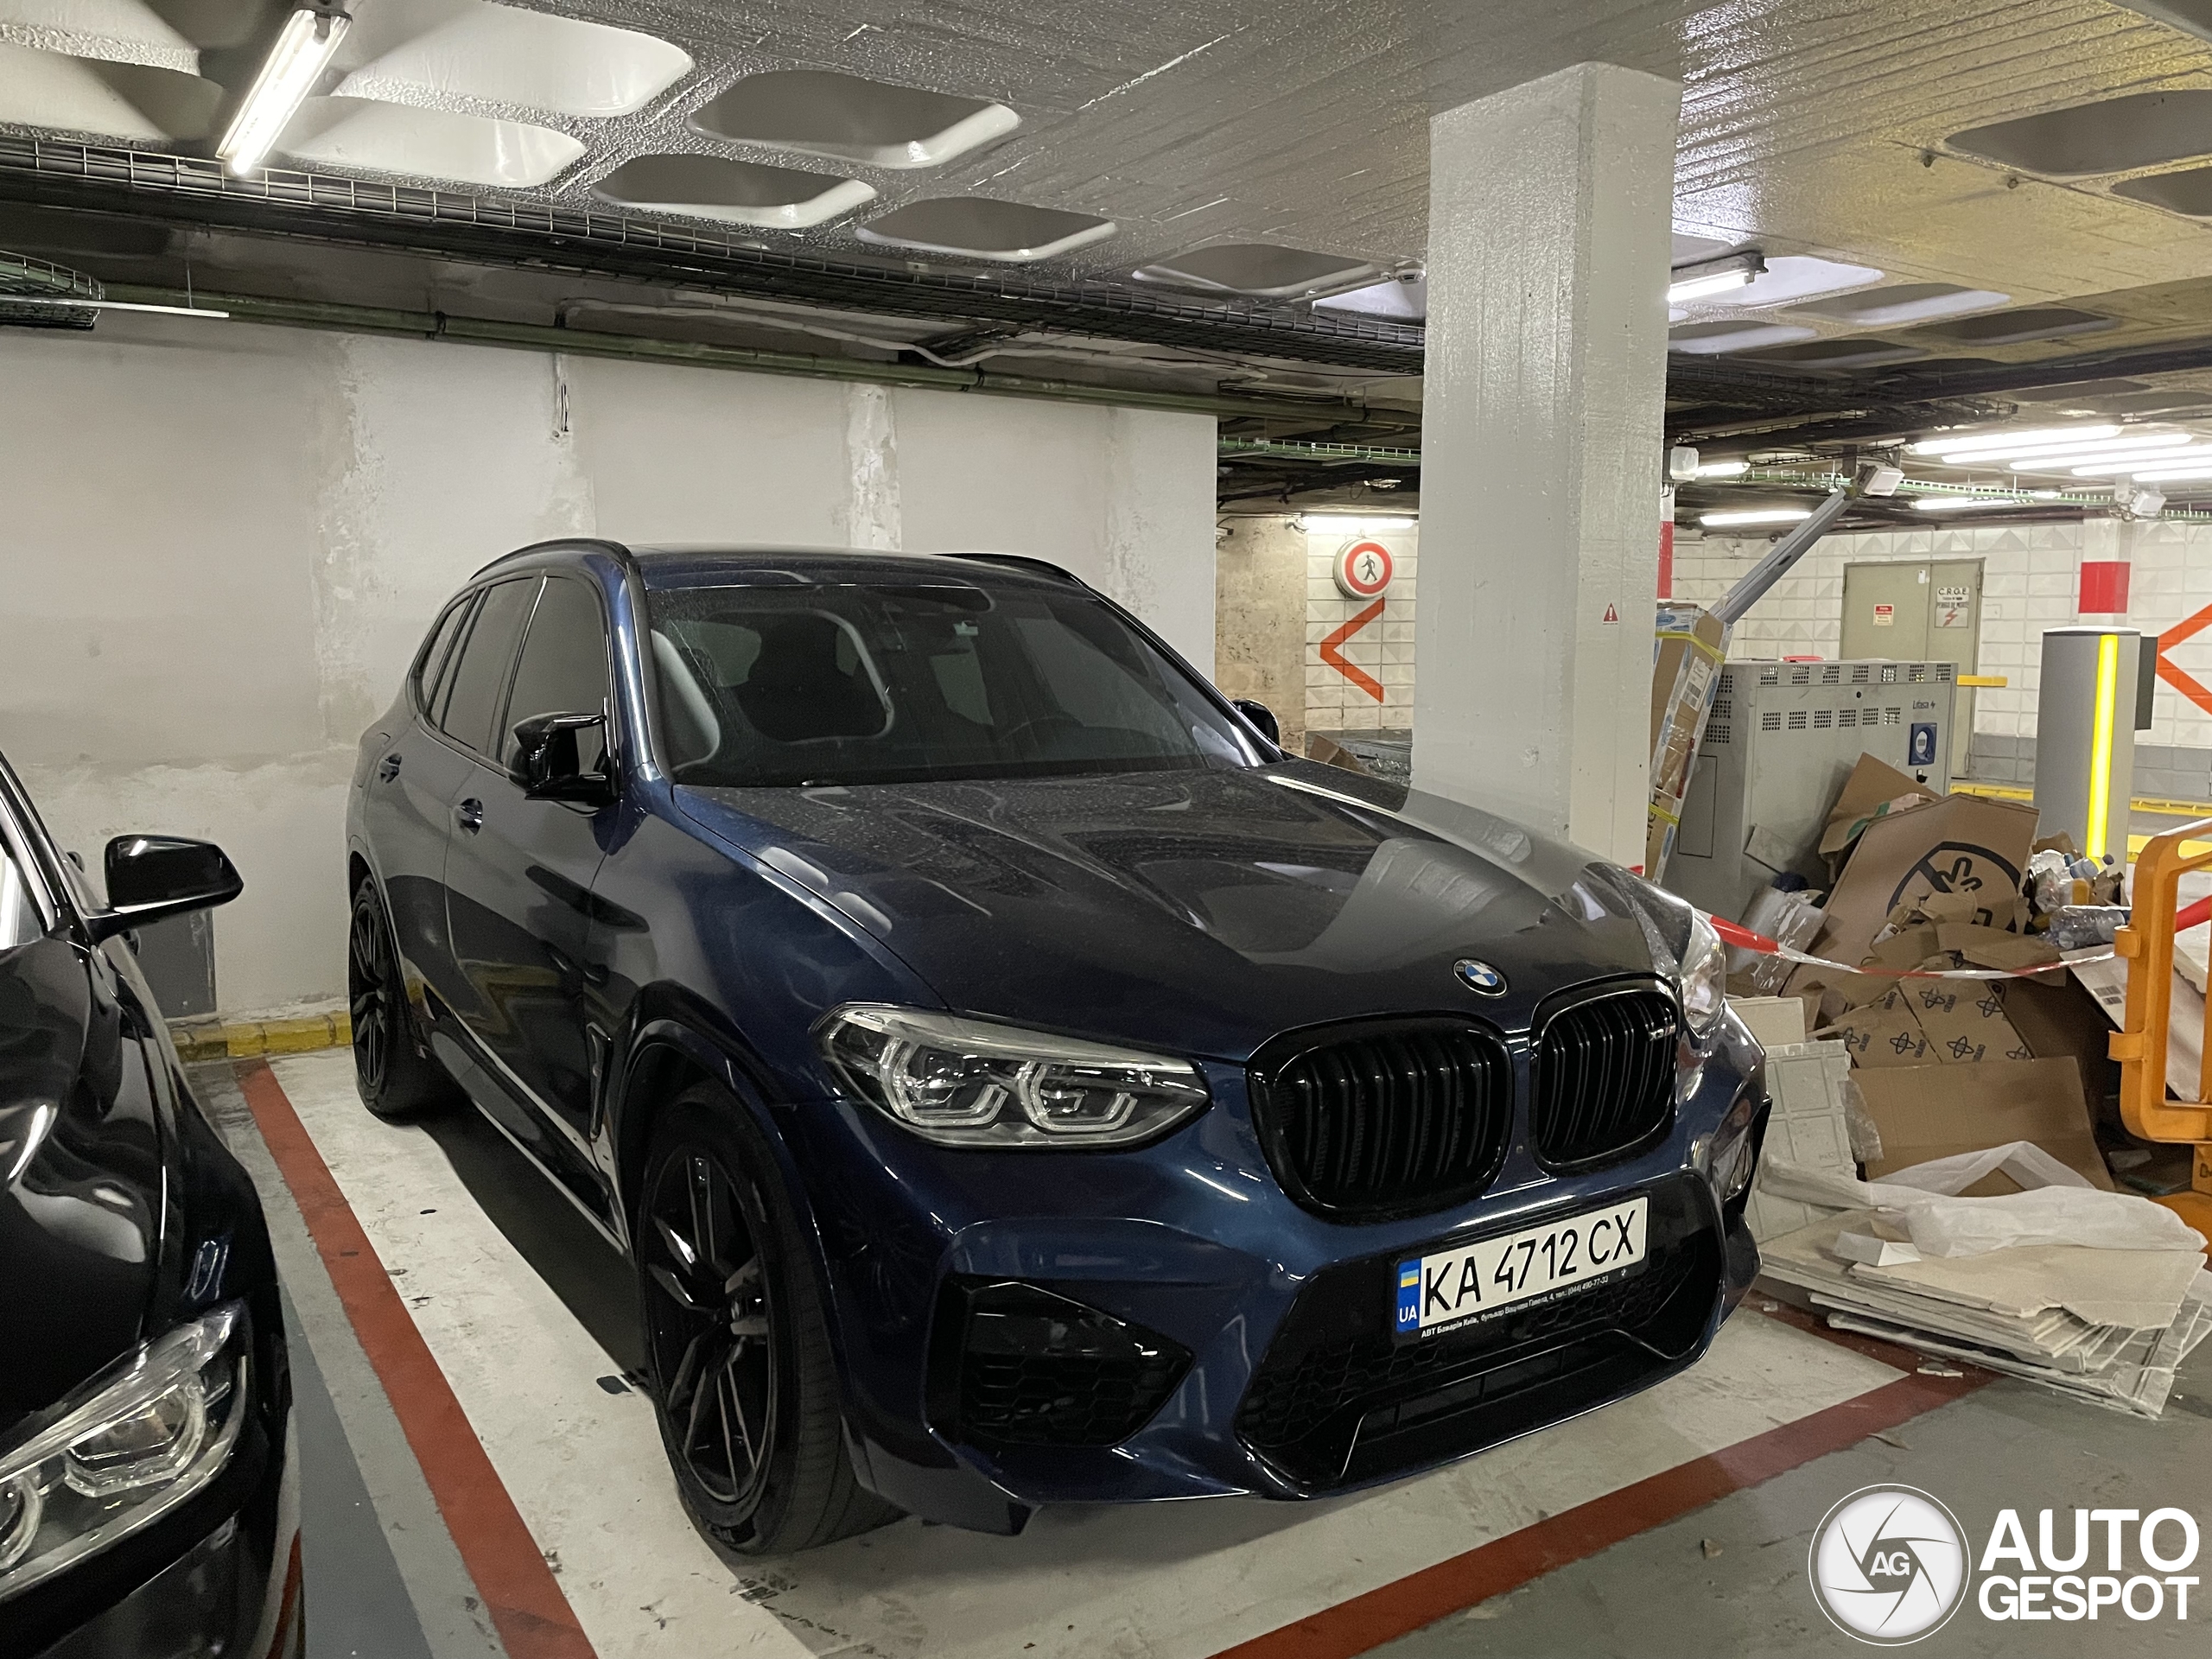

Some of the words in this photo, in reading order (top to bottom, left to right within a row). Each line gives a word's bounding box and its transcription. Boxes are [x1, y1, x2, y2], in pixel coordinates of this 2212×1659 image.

[1424, 1255, 1482, 1317] KA
[1494, 1229, 1579, 1293] 4712
[1587, 1210, 1636, 1265] CX
[1399, 1305, 1417, 1323] UA
